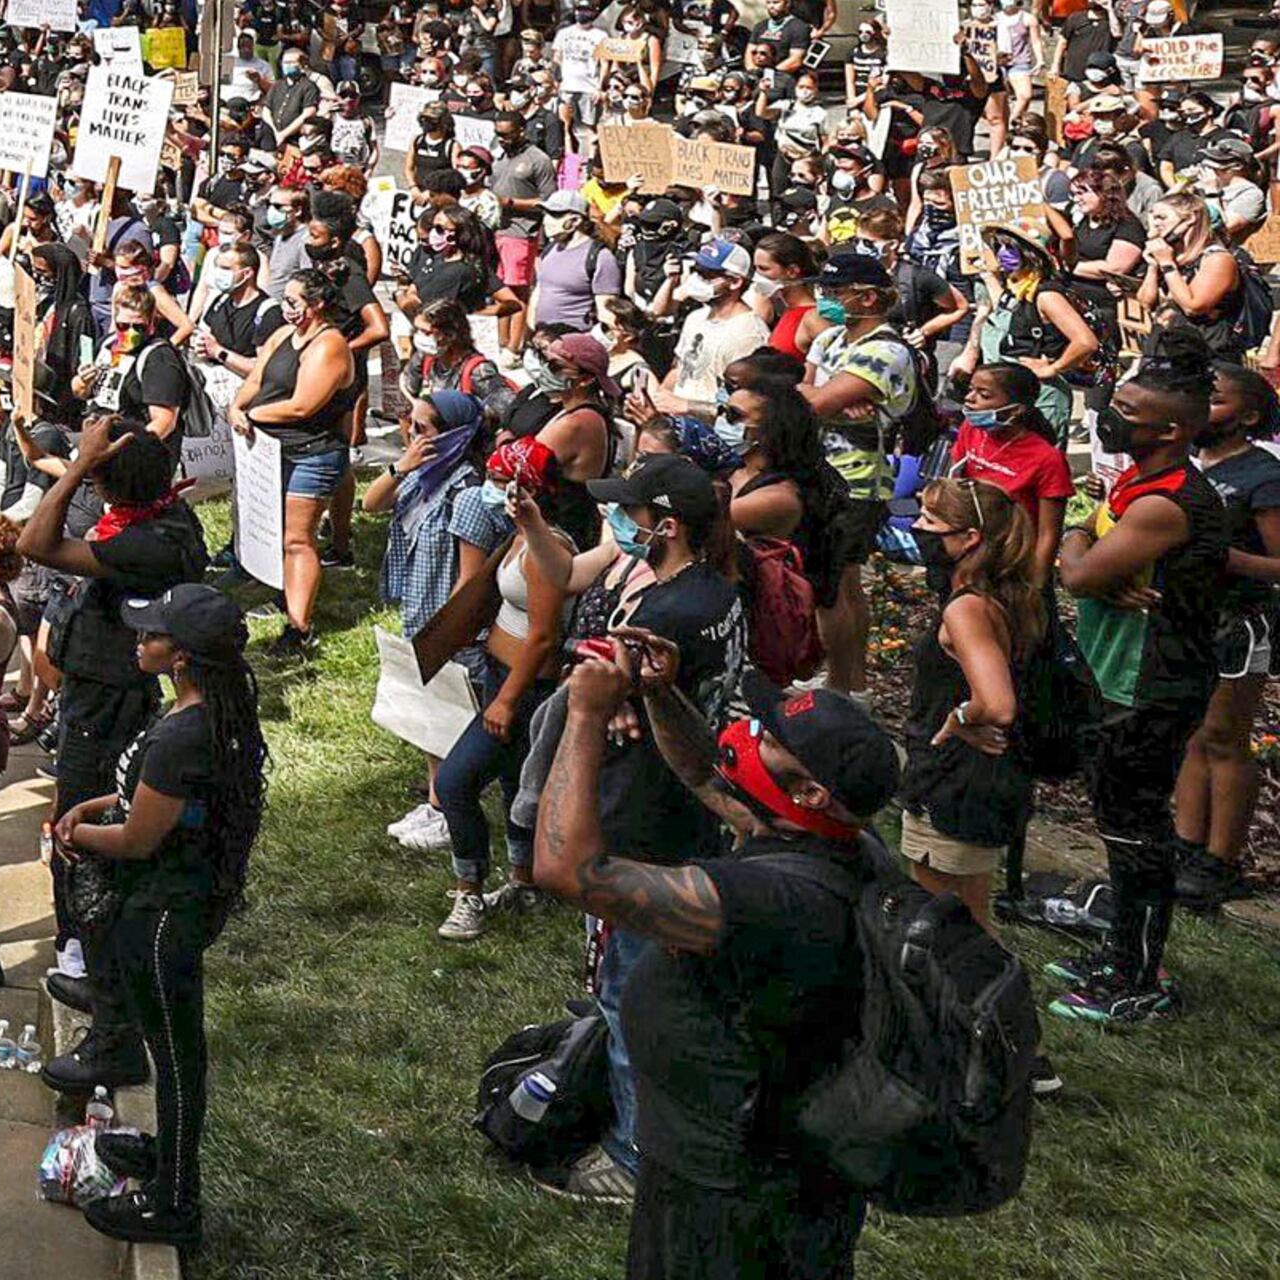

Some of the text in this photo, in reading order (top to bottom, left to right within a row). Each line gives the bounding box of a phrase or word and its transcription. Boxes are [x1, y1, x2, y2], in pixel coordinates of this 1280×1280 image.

[1195, 41, 1218, 53] the
[107, 74, 150, 95] BLACK
[106, 91, 149, 111] TRANS
[102, 109, 140, 126] LIVES
[89, 122, 147, 147] MATTER
[607, 142, 658, 160] LIVES
[719, 147, 751, 169] TRANS
[713, 167, 751, 188] MATTER
[968, 161, 1019, 187] OUR
[957, 180, 1044, 212] FRIENDS
